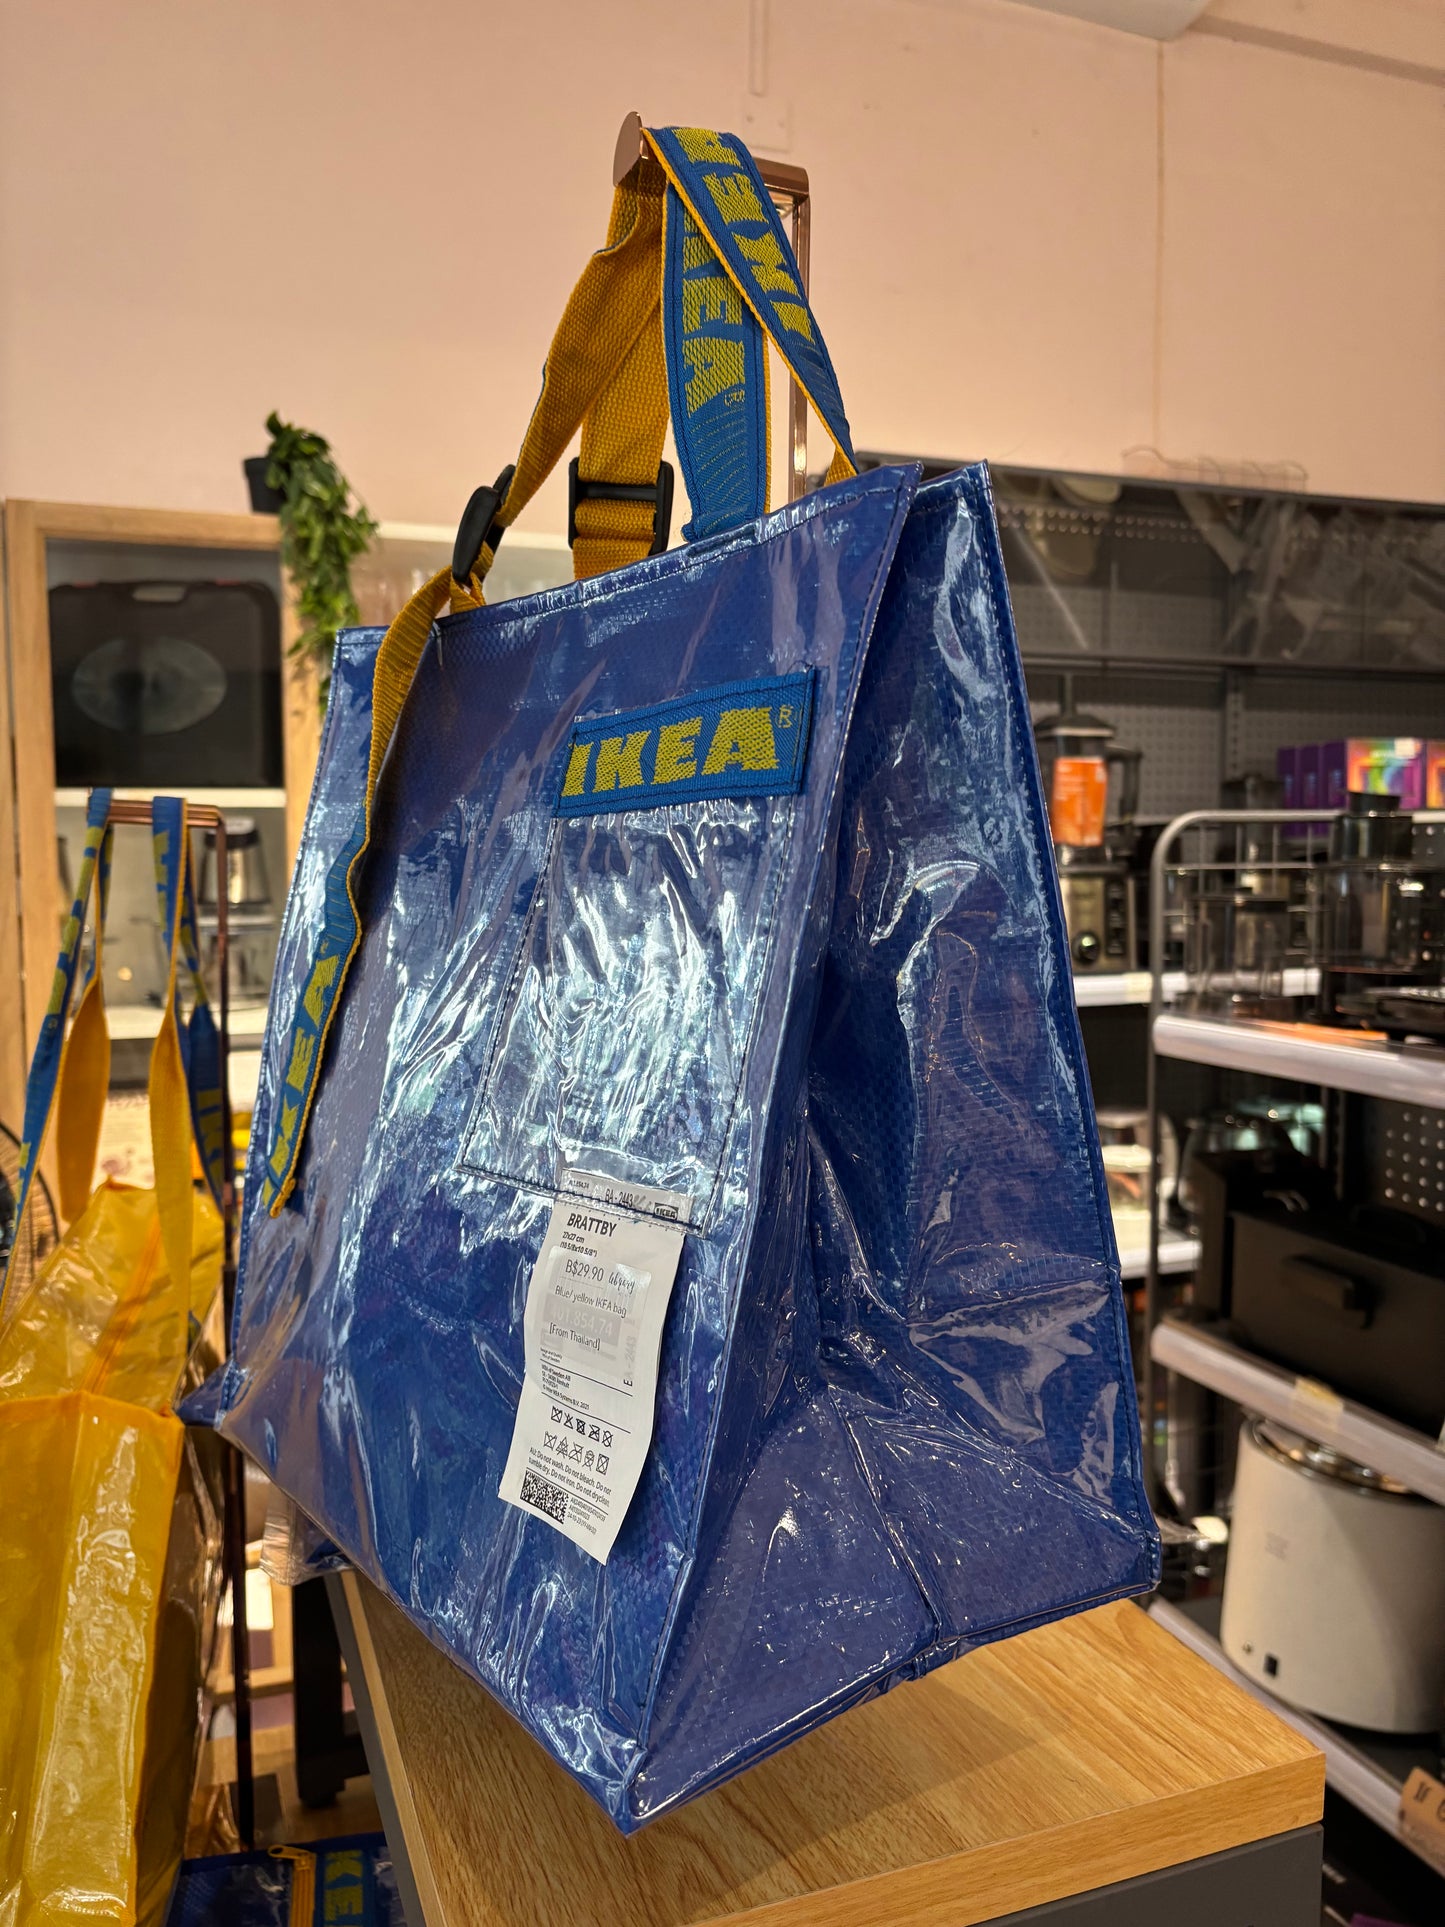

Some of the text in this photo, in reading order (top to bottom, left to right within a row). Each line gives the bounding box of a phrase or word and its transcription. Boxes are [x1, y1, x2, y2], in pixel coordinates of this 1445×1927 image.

[672, 127, 817, 346] IKEA
[561, 706, 780, 797] IKEA
[566, 1212, 617, 1238] BRATTBY
[576, 1236, 585, 1244] cm
[565, 1258, 605, 1282] B$29.90
[572, 1292, 595, 1306] yellow
[612, 1303, 627, 1319] bag
[549, 1322, 601, 1351] [From Thailand]
[537, 1450, 544, 1460] Do
[543, 1455, 551, 1465] not
[565, 1464, 572, 1475] Do
[571, 1470, 579, 1479] not
[595, 1481, 603, 1491] Do
[603, 1486, 612, 1496] not
[550, 1468, 558, 1479] Do
[557, 1473, 566, 1483] not
[576, 1482, 583, 1492] Do
[583, 1487, 591, 1497] not
